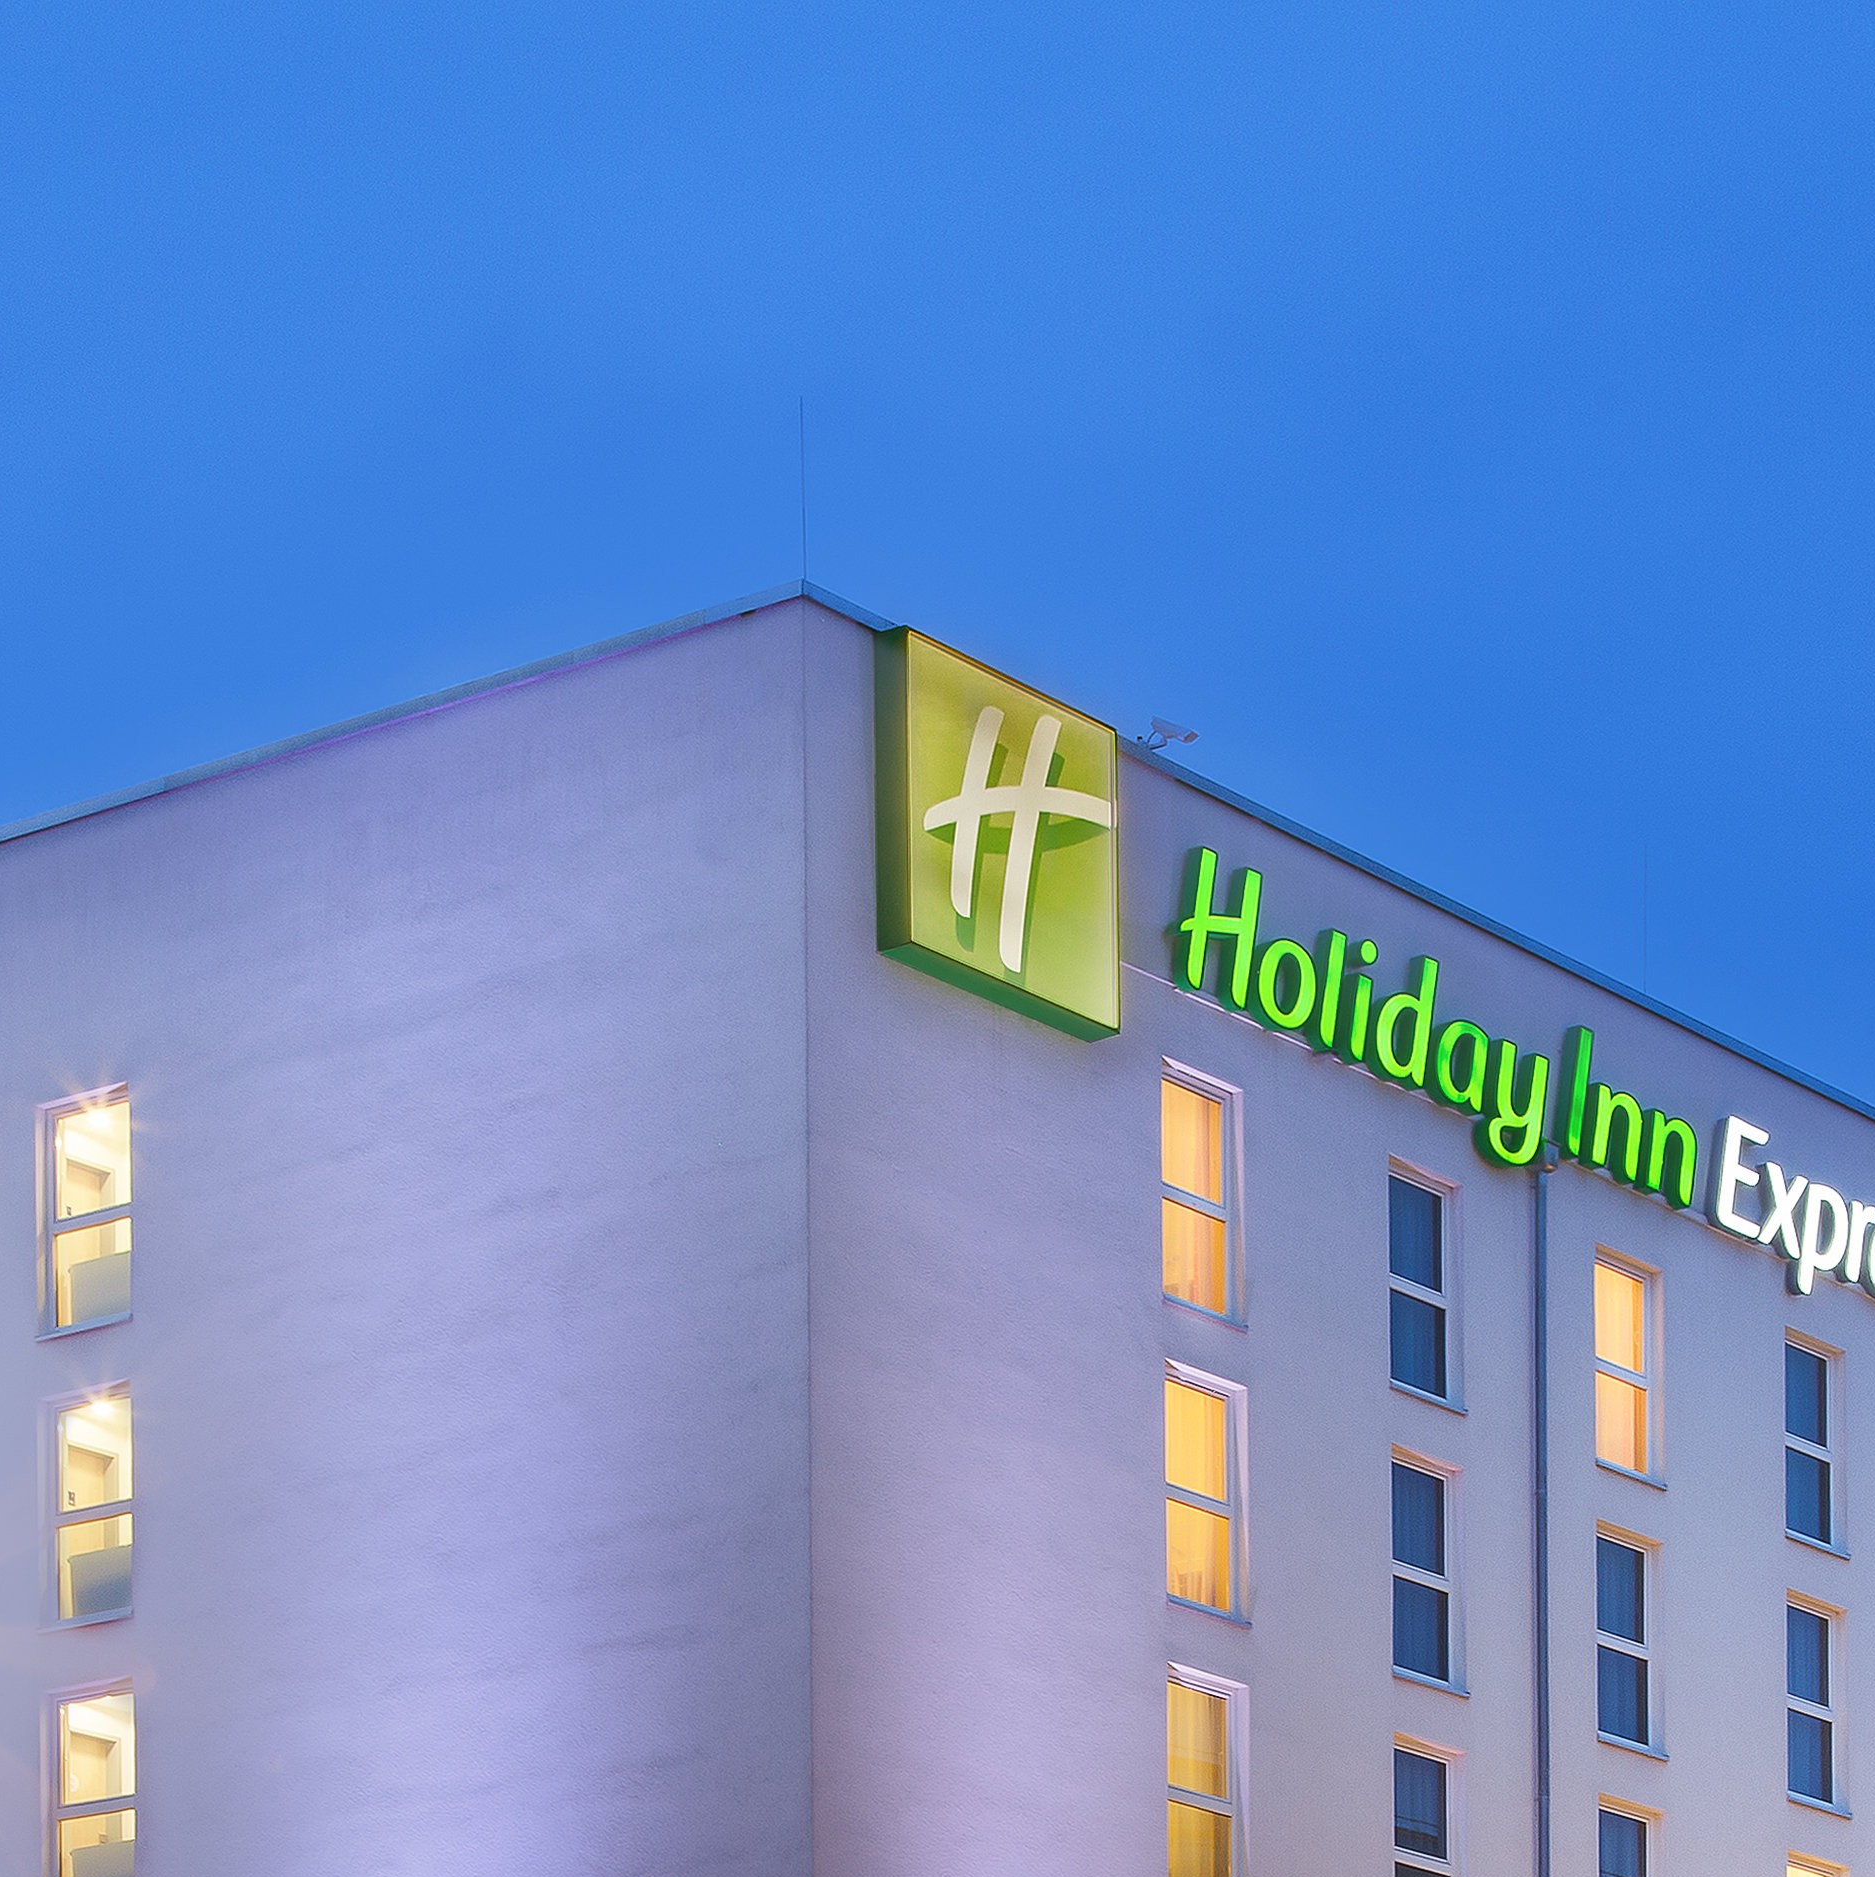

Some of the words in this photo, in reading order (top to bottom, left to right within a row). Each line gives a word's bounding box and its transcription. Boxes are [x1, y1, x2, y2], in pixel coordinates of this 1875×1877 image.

[924, 706, 1115, 972] H
[1178, 846, 1550, 1167] Holiday
[1559, 1026, 1697, 1210] Inn
